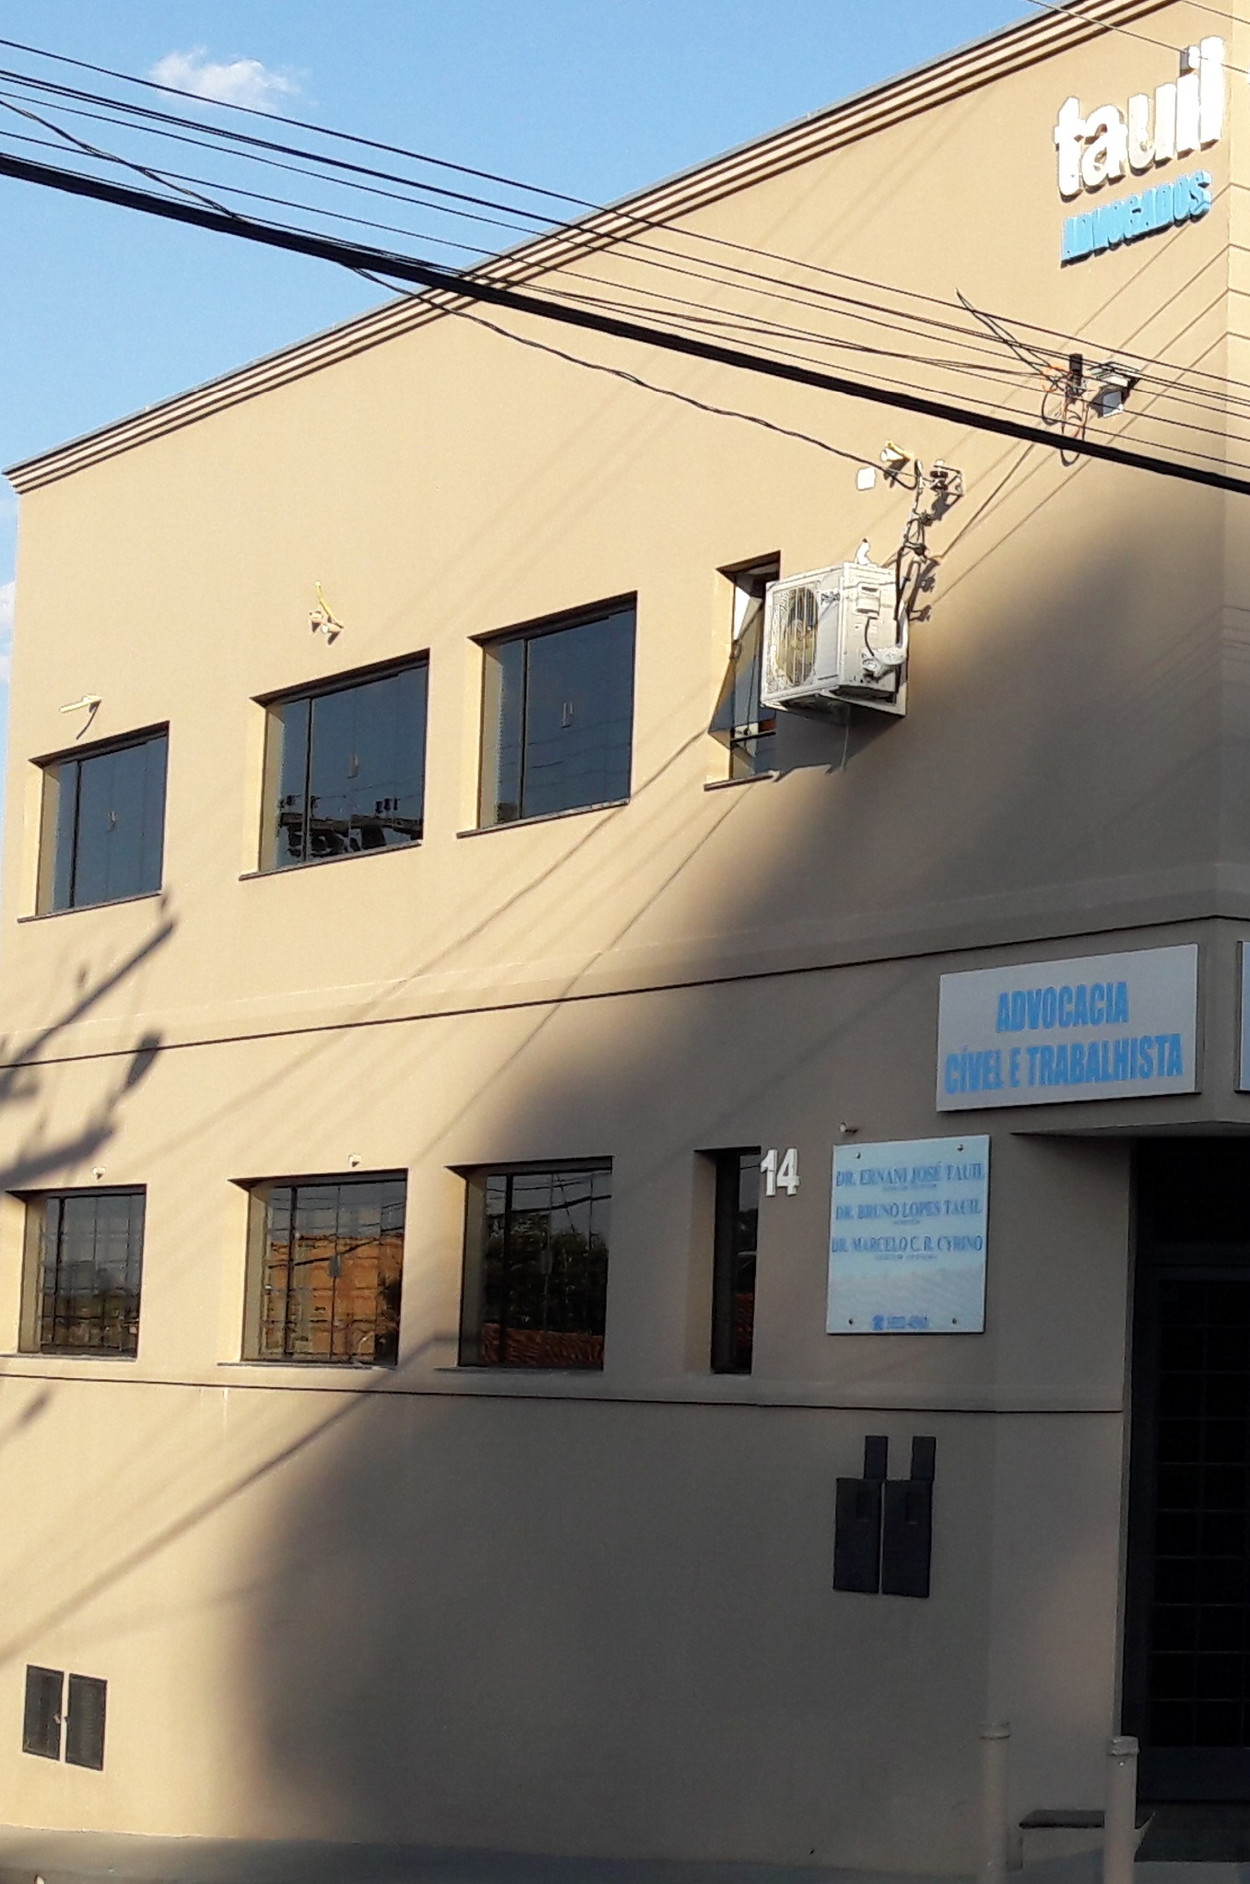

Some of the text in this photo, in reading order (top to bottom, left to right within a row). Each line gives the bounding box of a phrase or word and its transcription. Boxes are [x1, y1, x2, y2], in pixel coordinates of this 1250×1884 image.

[1053, 35, 1226, 201] tauil
[996, 981, 1130, 1033] ADVOCACIA
[945, 1033, 1184, 1095] CÍVEL E TRABALHISTA
[760, 1148, 800, 1197] 14
